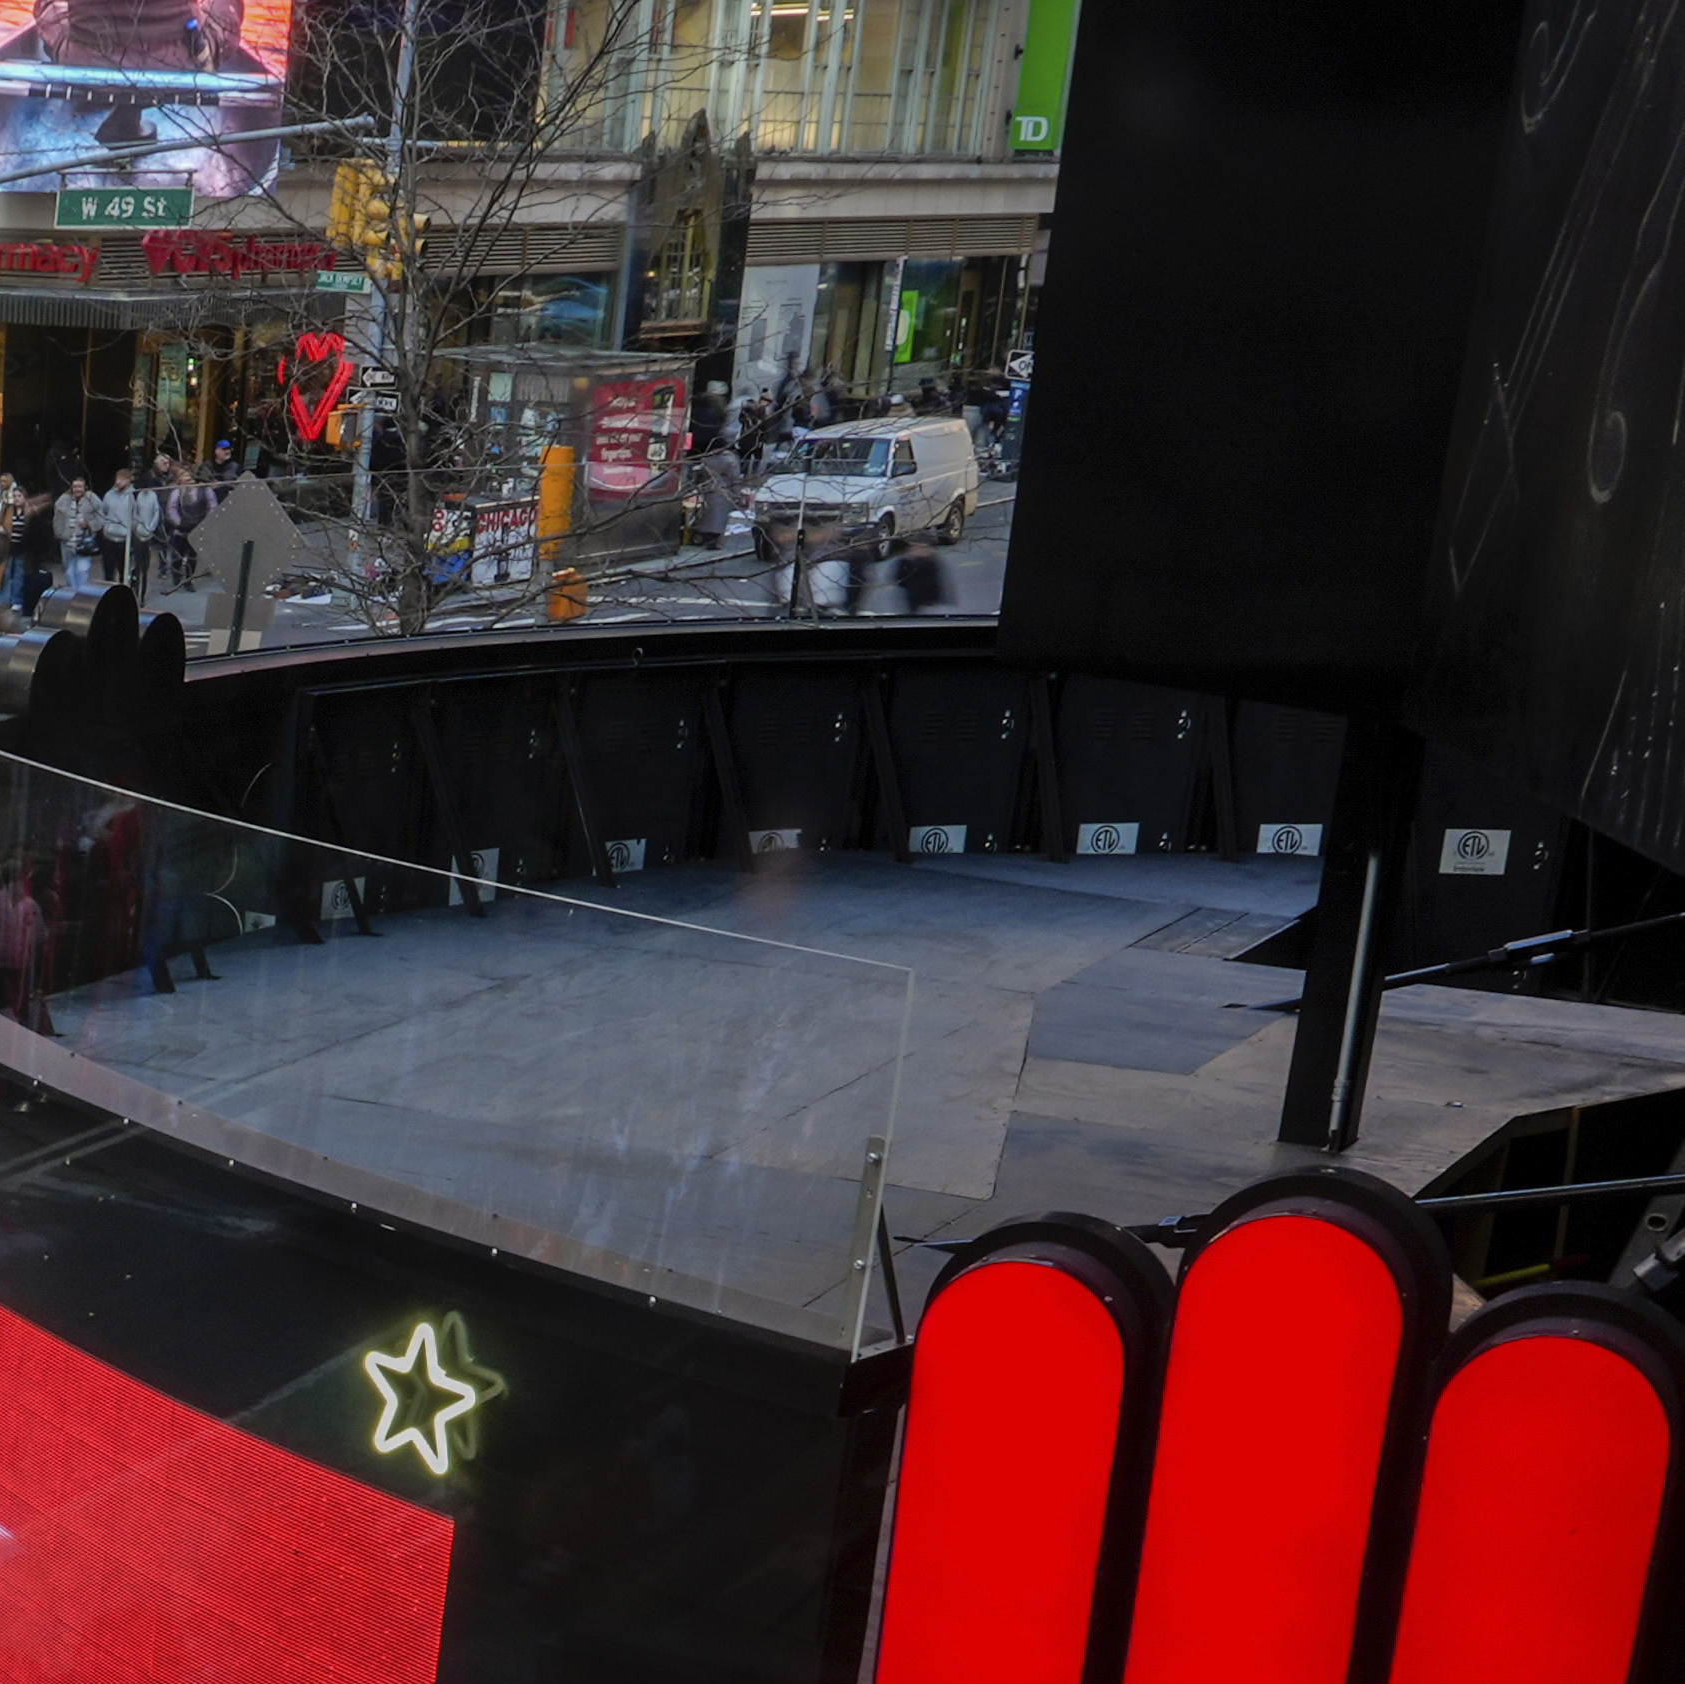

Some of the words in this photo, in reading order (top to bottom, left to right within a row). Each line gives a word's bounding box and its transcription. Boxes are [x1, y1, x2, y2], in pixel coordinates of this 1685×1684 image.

[1015, 115, 1049, 141] TD
[81, 199, 99, 219] W
[106, 197, 133, 219] 49
[139, 195, 166, 217] St
